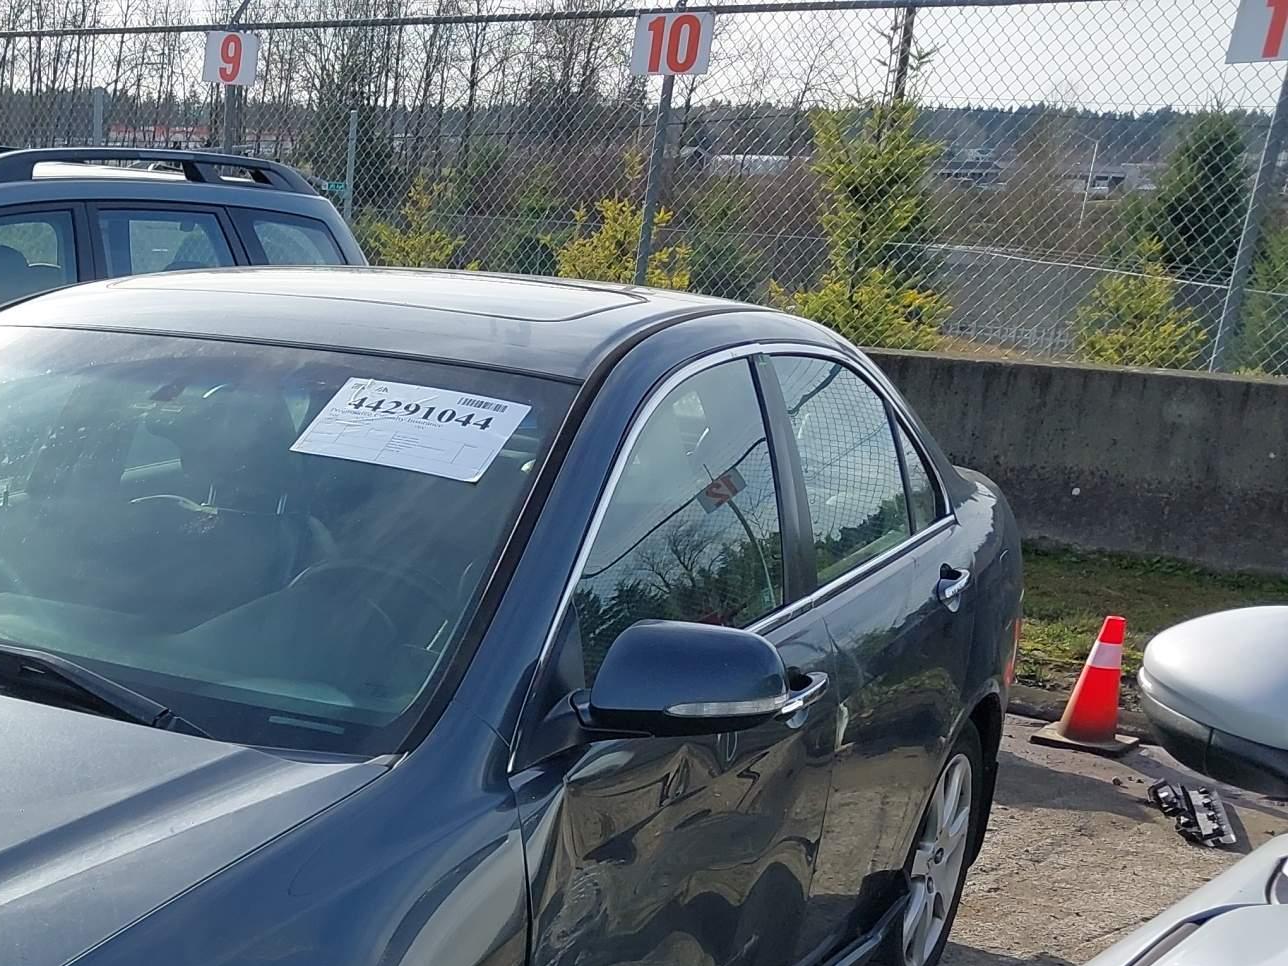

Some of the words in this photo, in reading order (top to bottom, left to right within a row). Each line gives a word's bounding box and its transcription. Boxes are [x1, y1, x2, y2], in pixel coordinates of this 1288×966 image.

[219, 34, 242, 82] 9
[647, 14, 701, 73] 10
[348, 396, 495, 431] 44291044
